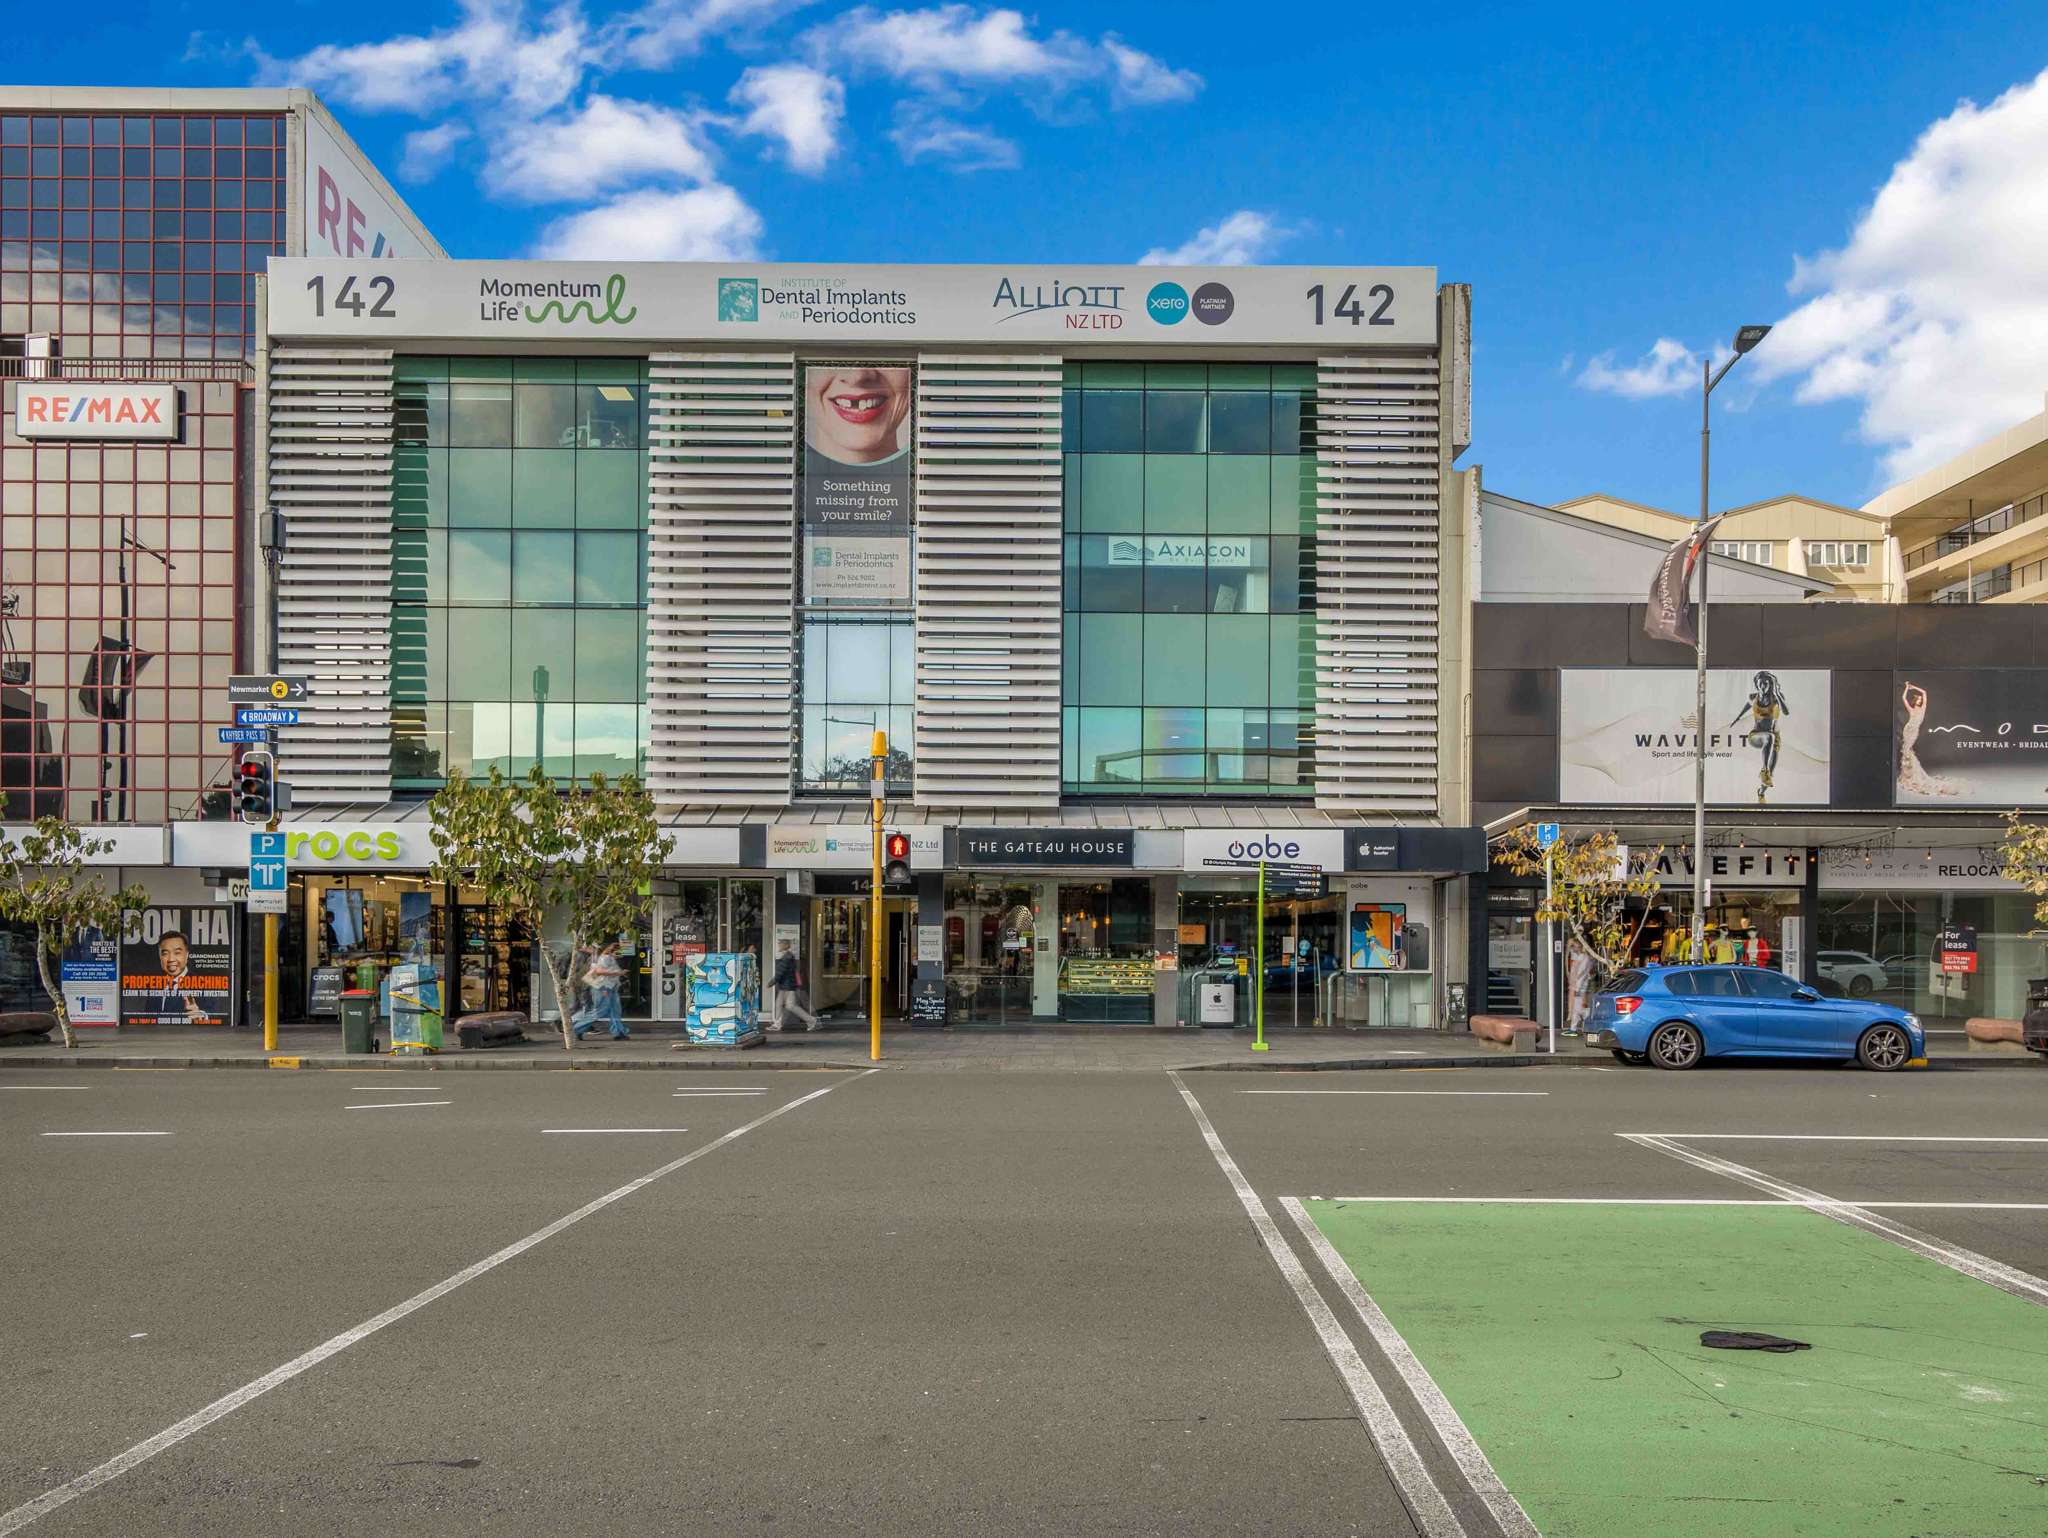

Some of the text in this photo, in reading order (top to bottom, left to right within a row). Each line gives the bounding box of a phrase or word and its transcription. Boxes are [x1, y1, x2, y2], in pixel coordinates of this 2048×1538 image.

[480, 278, 601, 298] Momentum
[781, 279, 847, 288] INSTITUTE OF
[306, 275, 396, 318] 142
[761, 288, 906, 308] Dental Implants
[1150, 297, 1185, 310] xero
[1307, 283, 1396, 326] 142
[779, 307, 916, 324] AND Periodontics
[1066, 314, 1122, 329] NZ LTD
[27, 396, 162, 424] RE/MAX
[823, 480, 891, 494] Something
[815, 495, 898, 508] missing from
[821, 510, 892, 522] your smile?
[1158, 541, 1246, 557] AXIACON
[835, 552, 899, 562] Dental Implants
[843, 560, 894, 568] Periodontics
[230, 685, 270, 693] Newmarket
[248, 711, 287, 722] BROADWAY
[225, 730, 266, 740] KHYBER PASS RD
[1635, 734, 1749, 748] WAVFIT
[1651, 750, 1671, 758] Sport
[1686, 750, 1714, 758] lifeyle
[261, 836, 275, 853] P
[287, 831, 400, 860] rocs
[925, 841, 939, 849] Ltd
[969, 842, 1124, 853] THE GATEAU HOUSE
[851, 880, 870, 891] 14
[123, 909, 230, 945] DON HA
[675, 923, 689, 931] For
[675, 933, 697, 941] lease
[1945, 931, 1960, 939] For
[90, 946, 101, 954] THE
[1945, 940, 1968, 949] lease
[123, 975, 174, 989] PROPERTY
[177, 975, 229, 989] COACHING
[123, 989, 138, 997] LEARN
[139, 989, 149, 997] THE
[178, 989, 203, 997] PROPERTY
[203, 989, 229, 997] INVESTING
